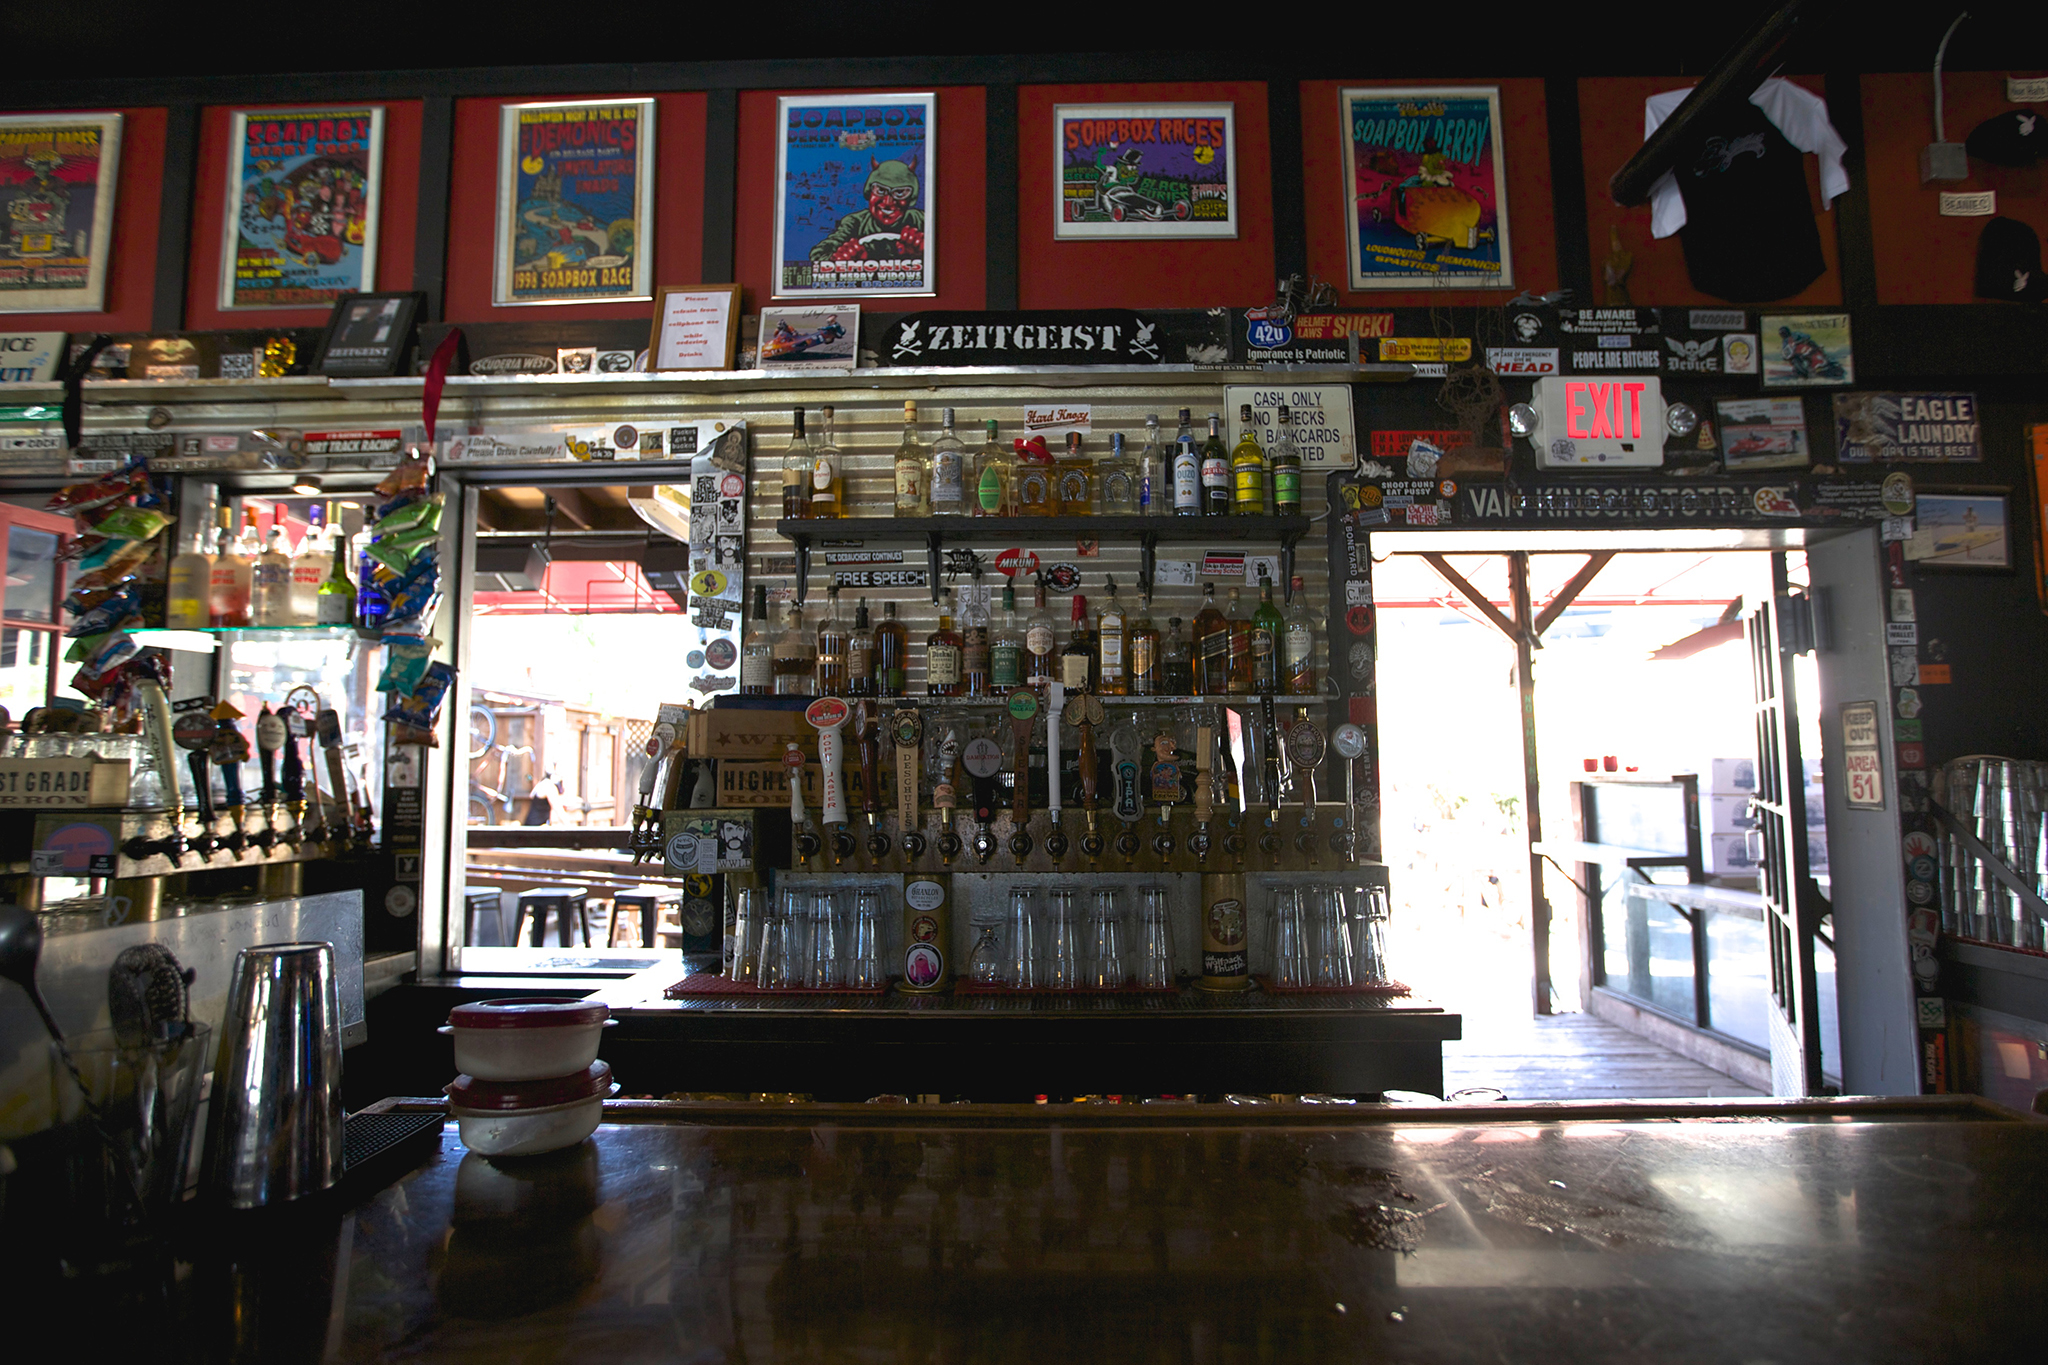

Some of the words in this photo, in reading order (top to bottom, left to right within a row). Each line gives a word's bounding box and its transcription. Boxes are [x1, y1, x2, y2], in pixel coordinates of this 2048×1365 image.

[789, 107, 925, 128] SOAPBOX
[247, 119, 368, 145] SOAPBOX
[531, 120, 636, 158] DEMONICS
[788, 129, 841, 143] DERBY
[874, 127, 926, 141] RACES
[1064, 118, 1157, 151] SOAPBOX
[1159, 118, 1224, 148] RACES
[1353, 117, 1431, 154] SOAPBOX
[1434, 116, 1490, 167] DERBY
[1140, 177, 1189, 193] BLACK
[820, 259, 923, 273] DEMONICS
[541, 268, 598, 288] SOAPBOX
[600, 267, 632, 286] RACE
[839, 273, 874, 282] MERRY
[876, 271, 922, 281] WIDOWS
[1296, 315, 1332, 327] HELMET
[1579, 309, 1593, 320] BE
[1595, 309, 1636, 320] AWARE!
[1297, 326, 1323, 338] LAWS
[1332, 312, 1394, 338] SUCK!
[936, 324, 1132, 351] ZEITGEIST
[1247, 348, 1294, 360] Ignorance
[1295, 348, 1304, 359] is
[1305, 348, 1346, 359] Patriotic
[1573, 351, 1604, 369] PEOPLE
[1605, 351, 1622, 368] ARE
[1622, 350, 1660, 368] BITCHES
[475, 357, 520, 370] SCUDERIA
[522, 357, 549, 368] WEST
[1494, 362, 1554, 373] HEAD
[1254, 392, 1284, 406] CASH
[1291, 392, 1321, 405] ONLY
[1566, 382, 1645, 438] EXIT
[1900, 397, 1972, 421] EAGLE
[1254, 411, 1271, 425] NO
[1285, 411, 1325, 425] HECKS
[1897, 424, 1978, 444] LAUNDRY
[1262, 447, 1324, 460] ACTED
[1881, 446, 1904, 456] ORK
[1907, 446, 1918, 456] IS
[1920, 446, 1941, 456] THE
[1945, 446, 1972, 456] BEST
[1177, 469, 1195, 479] OUZO
[1381, 481, 1410, 489] SHOOT
[1411, 480, 1435, 489] GUNS
[1386, 488, 1403, 496] EAT
[1404, 488, 1431, 496] PUSSY
[826, 553, 837, 562] THE
[873, 551, 903, 561] CONTINUES
[1345, 525, 1358, 577] BONEYARD
[999, 558, 1036, 568] MIKUNI
[835, 571, 869, 586] FREE
[871, 571, 926, 586] SPEECH
[1849, 727, 1872, 742] OUT
[1846, 754, 1878, 773] AREA
[723, 770, 815, 791] HIGHET
[1851, 774, 1876, 801] 51
[903, 754, 913, 827] DESCHUTES
[1125, 781, 1134, 809] IPA
